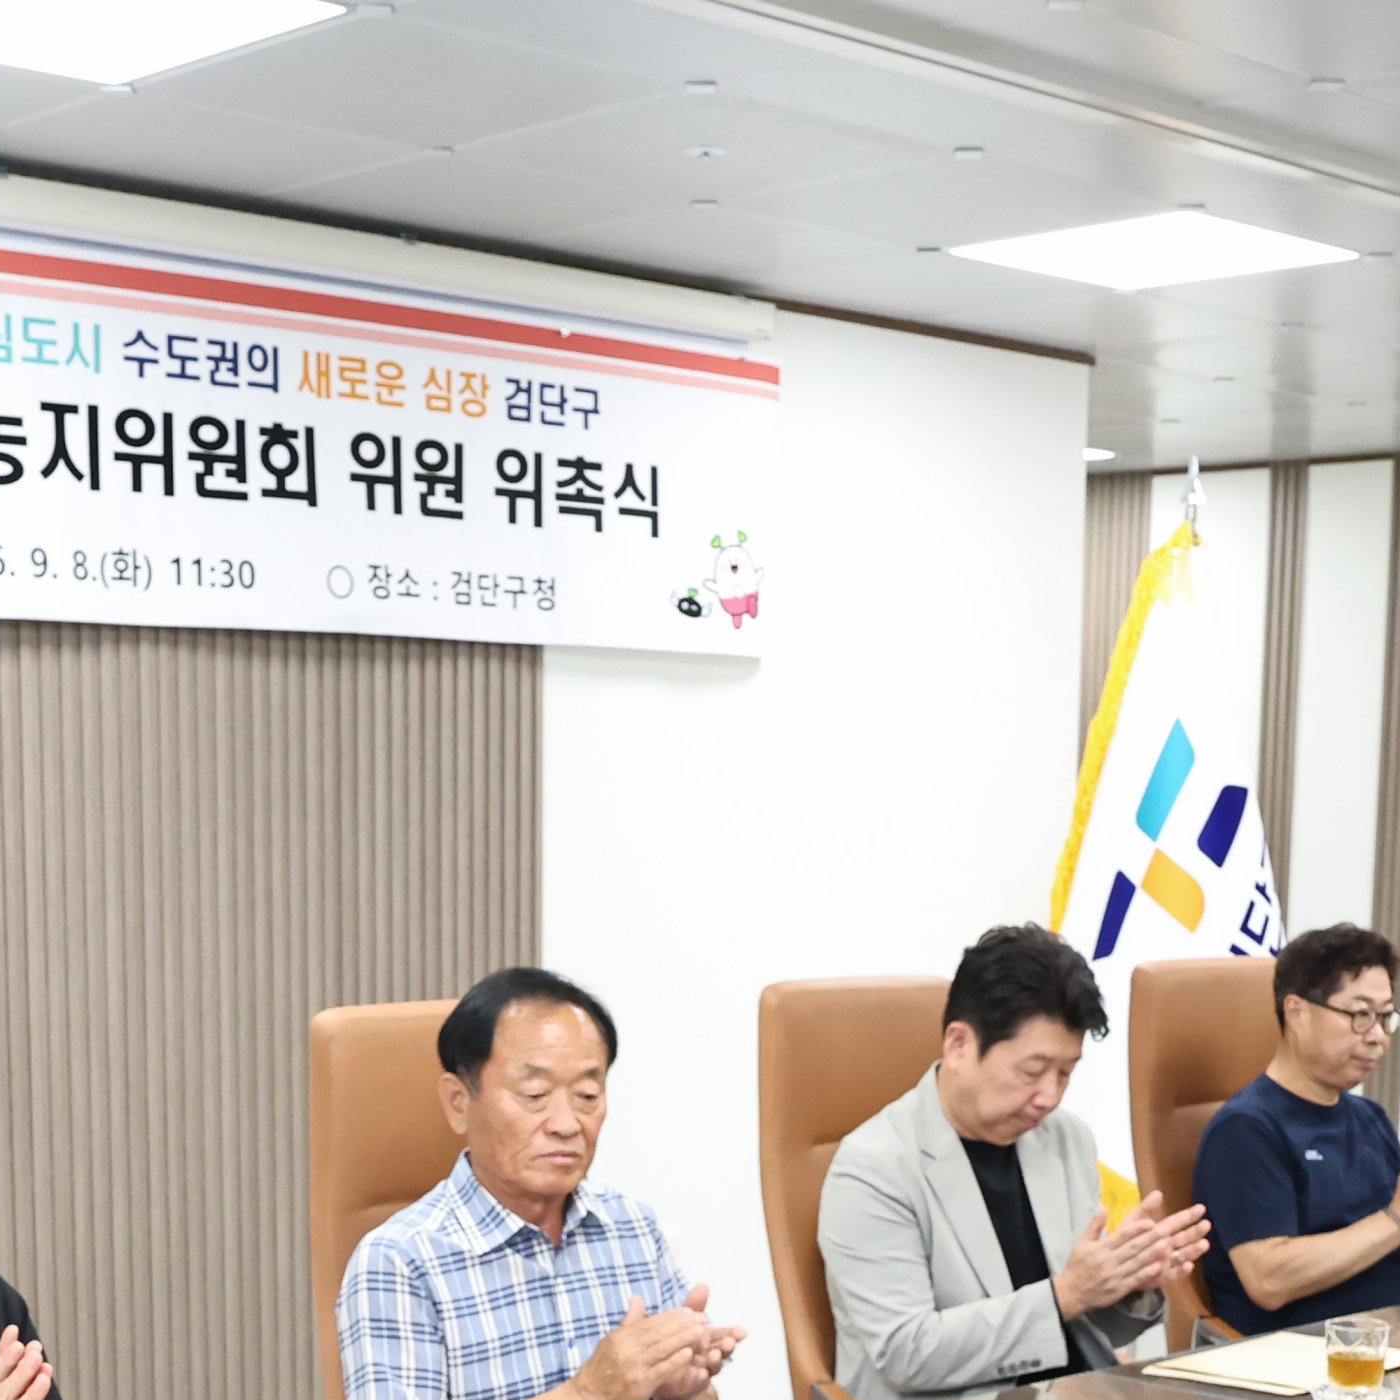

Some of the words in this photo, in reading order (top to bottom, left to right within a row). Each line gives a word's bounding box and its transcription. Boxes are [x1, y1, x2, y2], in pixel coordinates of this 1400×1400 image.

[123, 329, 280, 393] 수도권의
[299, 350, 406, 407] 새로운
[423, 366, 489, 418] 심장
[504, 377, 601, 430] 검단구
[350, 432, 464, 520] 위원
[494, 447, 660, 538] 위촉식
[171, 557, 255, 590] 11:30
[367, 563, 420, 601] 장소
[450, 570, 556, 611] 검단구청
